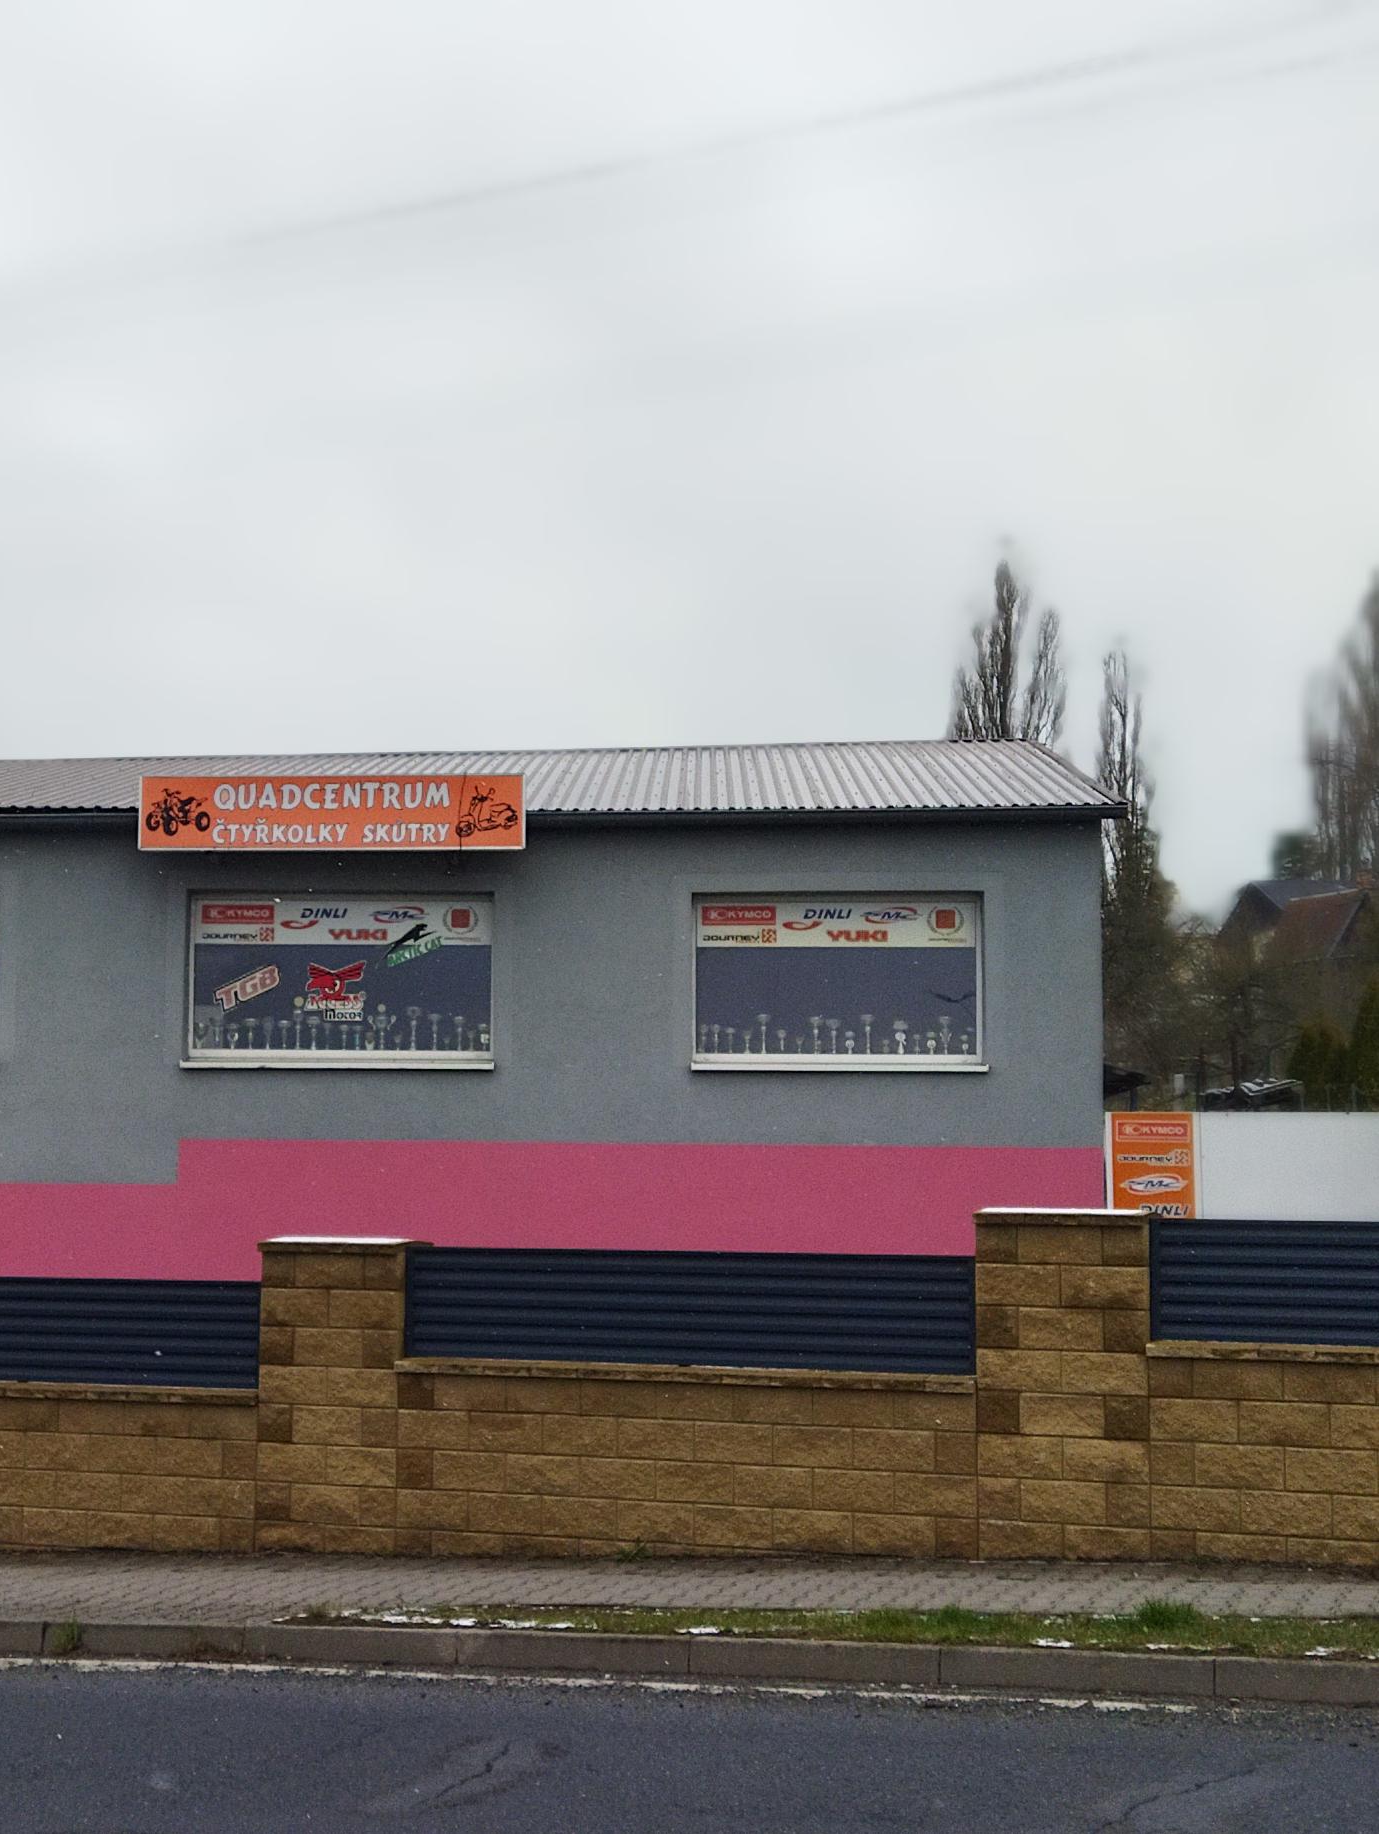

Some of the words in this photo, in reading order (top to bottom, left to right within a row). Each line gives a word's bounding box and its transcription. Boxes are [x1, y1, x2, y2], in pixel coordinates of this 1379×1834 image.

[213, 782, 450, 810] QUADCENTRUM
[212, 818, 348, 844] ČTYŘKOLKY
[300, 908, 348, 919] DINLI
[803, 908, 853, 920] DINLI
[328, 928, 388, 941] YUKI
[826, 929, 889, 942] YUKI
[424, 935, 443, 951] CAT
[215, 965, 280, 1011] TGB
[305, 994, 363, 1011] ACCESS
[1142, 1126, 1184, 1135] KYMCO
[1141, 1204, 1189, 1216] DINLI
